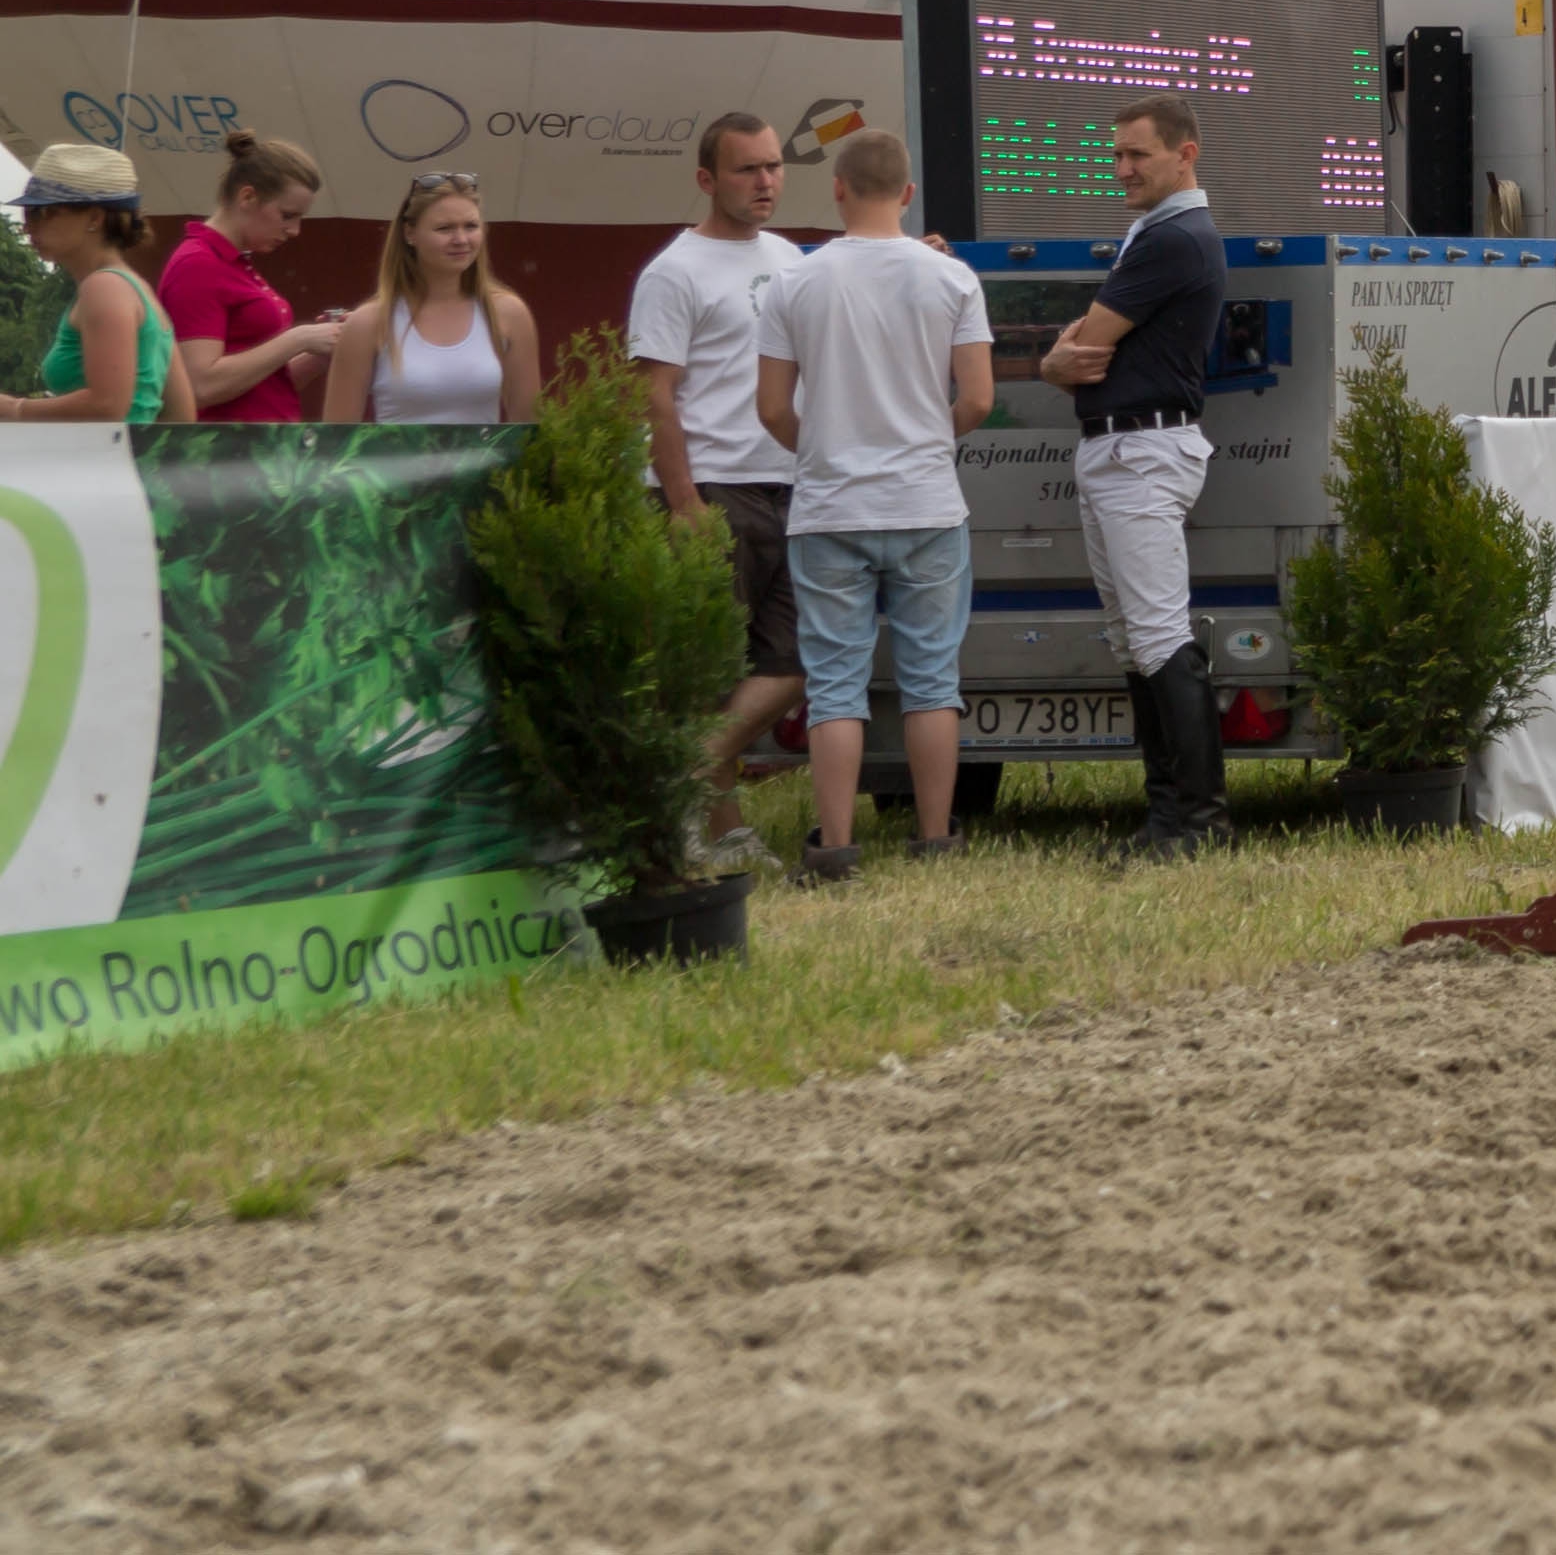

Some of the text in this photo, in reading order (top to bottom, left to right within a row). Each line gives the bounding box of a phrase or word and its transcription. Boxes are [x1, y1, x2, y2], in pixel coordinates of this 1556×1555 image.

[116, 92, 242, 135] OVER
[487, 110, 699, 143] overcloud
[1352, 281, 1382, 307] PAKI
[1384, 281, 1402, 307] NA
[1227, 437, 1292, 465] stajni
[1015, 696, 1128, 734] 738YF
